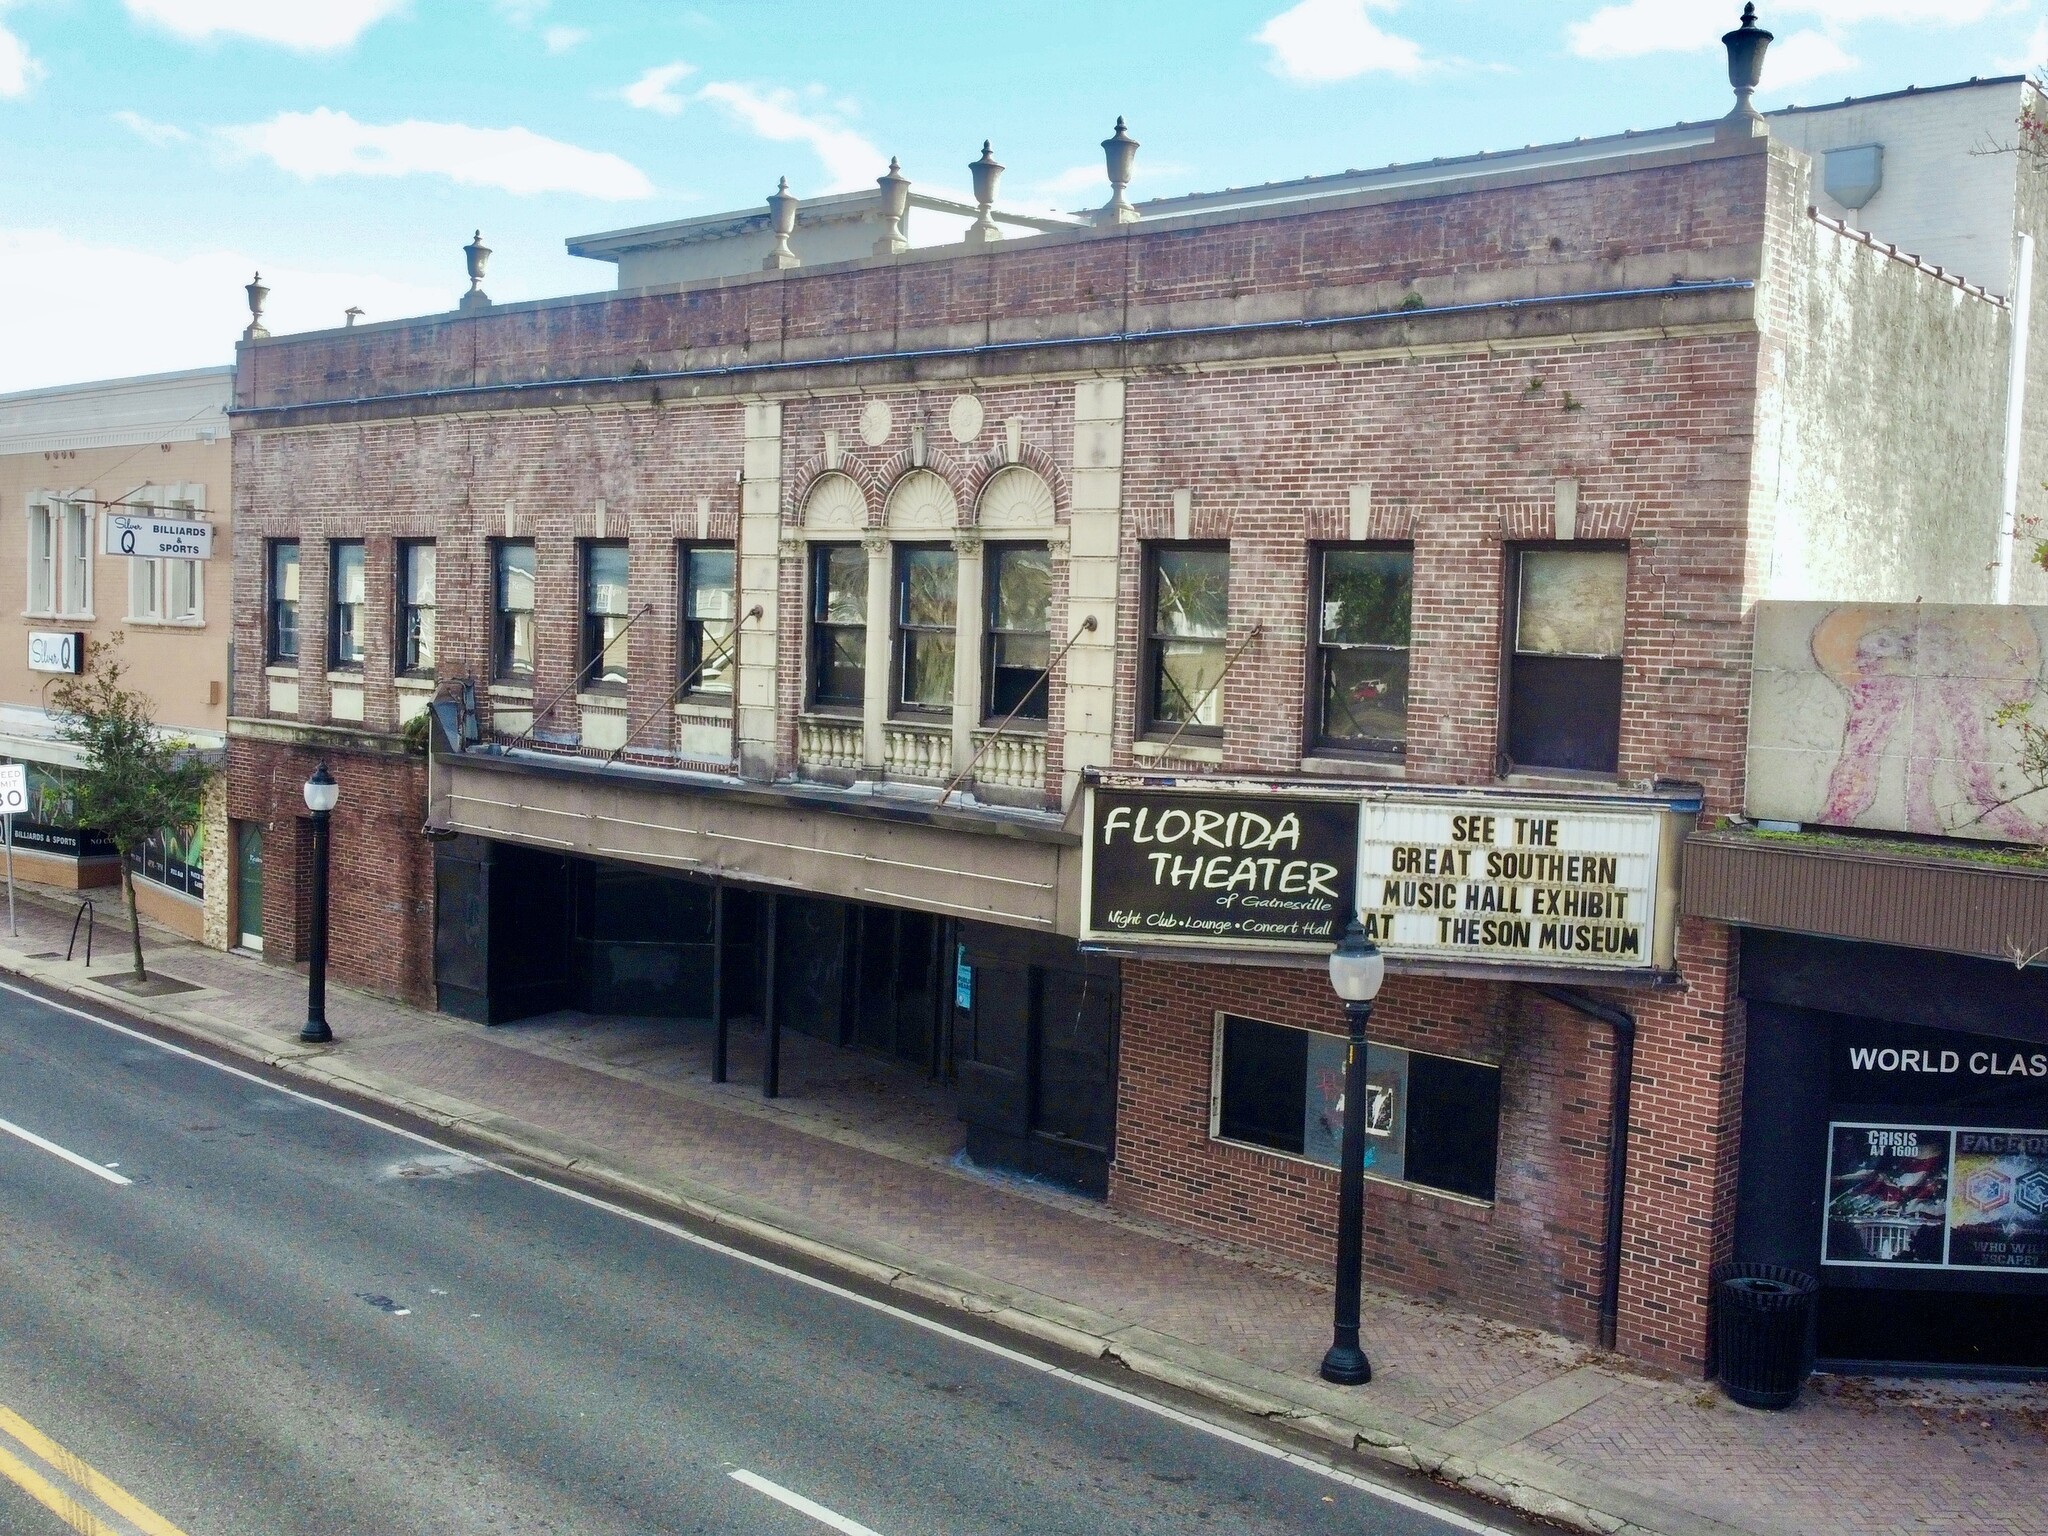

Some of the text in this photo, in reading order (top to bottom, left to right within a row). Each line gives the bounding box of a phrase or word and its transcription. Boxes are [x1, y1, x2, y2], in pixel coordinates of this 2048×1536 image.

[114, 516, 142, 530] Silver
[152, 525, 206, 537] BILLIARDS
[121, 530, 135, 554] Q
[159, 543, 199, 554] SPORTS
[32, 637, 70, 669] Silver Q
[14, 830, 44, 842] BILLIARDS
[46, 835, 51, 843] &
[52, 836, 76, 846] SPORTS
[1103, 807, 1300, 850] FLORIDA
[1452, 815, 1559, 846] SEE THE
[1148, 853, 1339, 897] THEATER
[1391, 846, 1617, 884] GREAT SOUTHERN
[1216, 893, 1332, 912] of Gainesville
[1382, 880, 1628, 919] MUSIC HALL EXHIBIT
[1108, 910, 1333, 935] Night Club Lounge Concert Hall
[1364, 913, 1639, 955] AT THESON MUSEUM
[1849, 1047, 2048, 1077] WORLD CLAS
[1867, 1130, 1918, 1147] CRISIS
[1870, 1145, 1919, 1158] AT 1600
[1973, 1241, 2007, 1253] WHO
